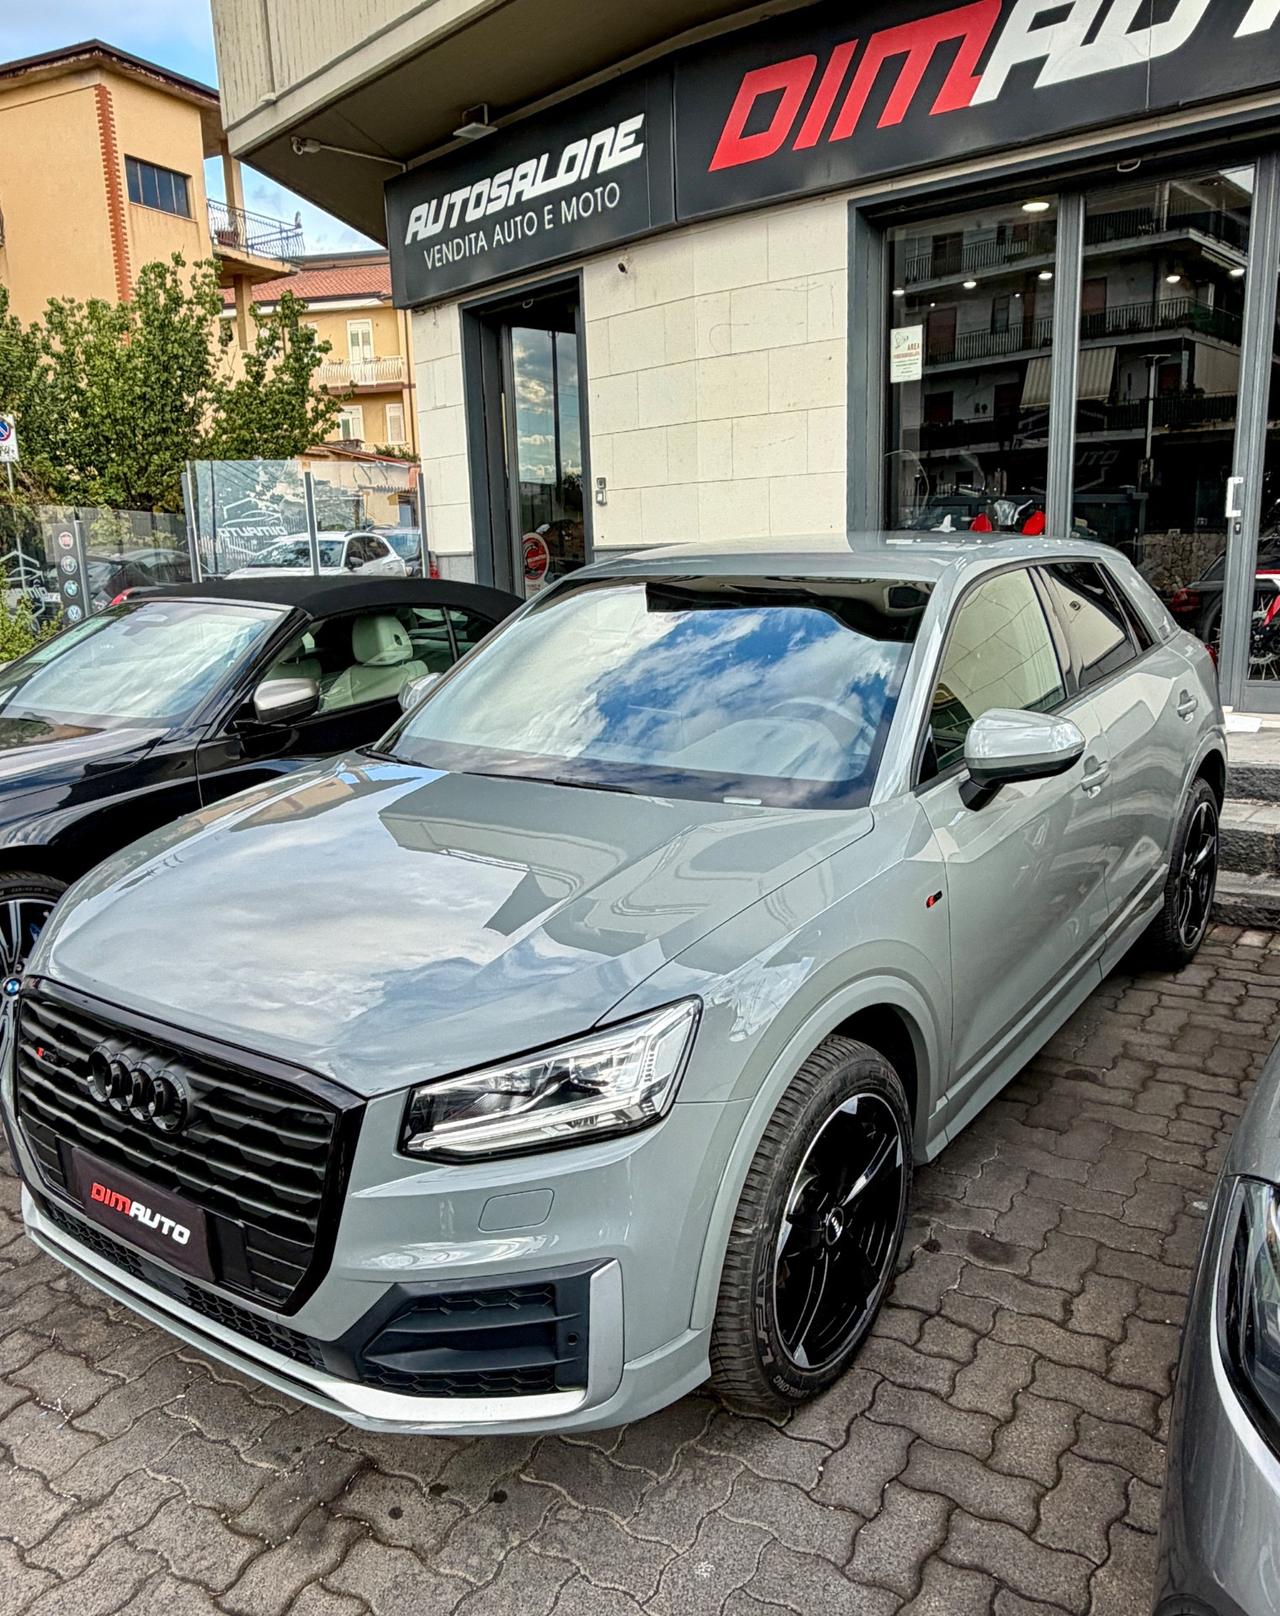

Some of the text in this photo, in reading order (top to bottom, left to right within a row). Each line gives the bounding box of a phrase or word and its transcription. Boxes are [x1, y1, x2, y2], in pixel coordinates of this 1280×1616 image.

[707, 0, 1280, 172] DIMAU
[405, 113, 645, 245] AUTOSALONE
[424, 182, 621, 270] VENDITA AUTO E MOTO
[90, 1182, 191, 1245] DIMAUTO
